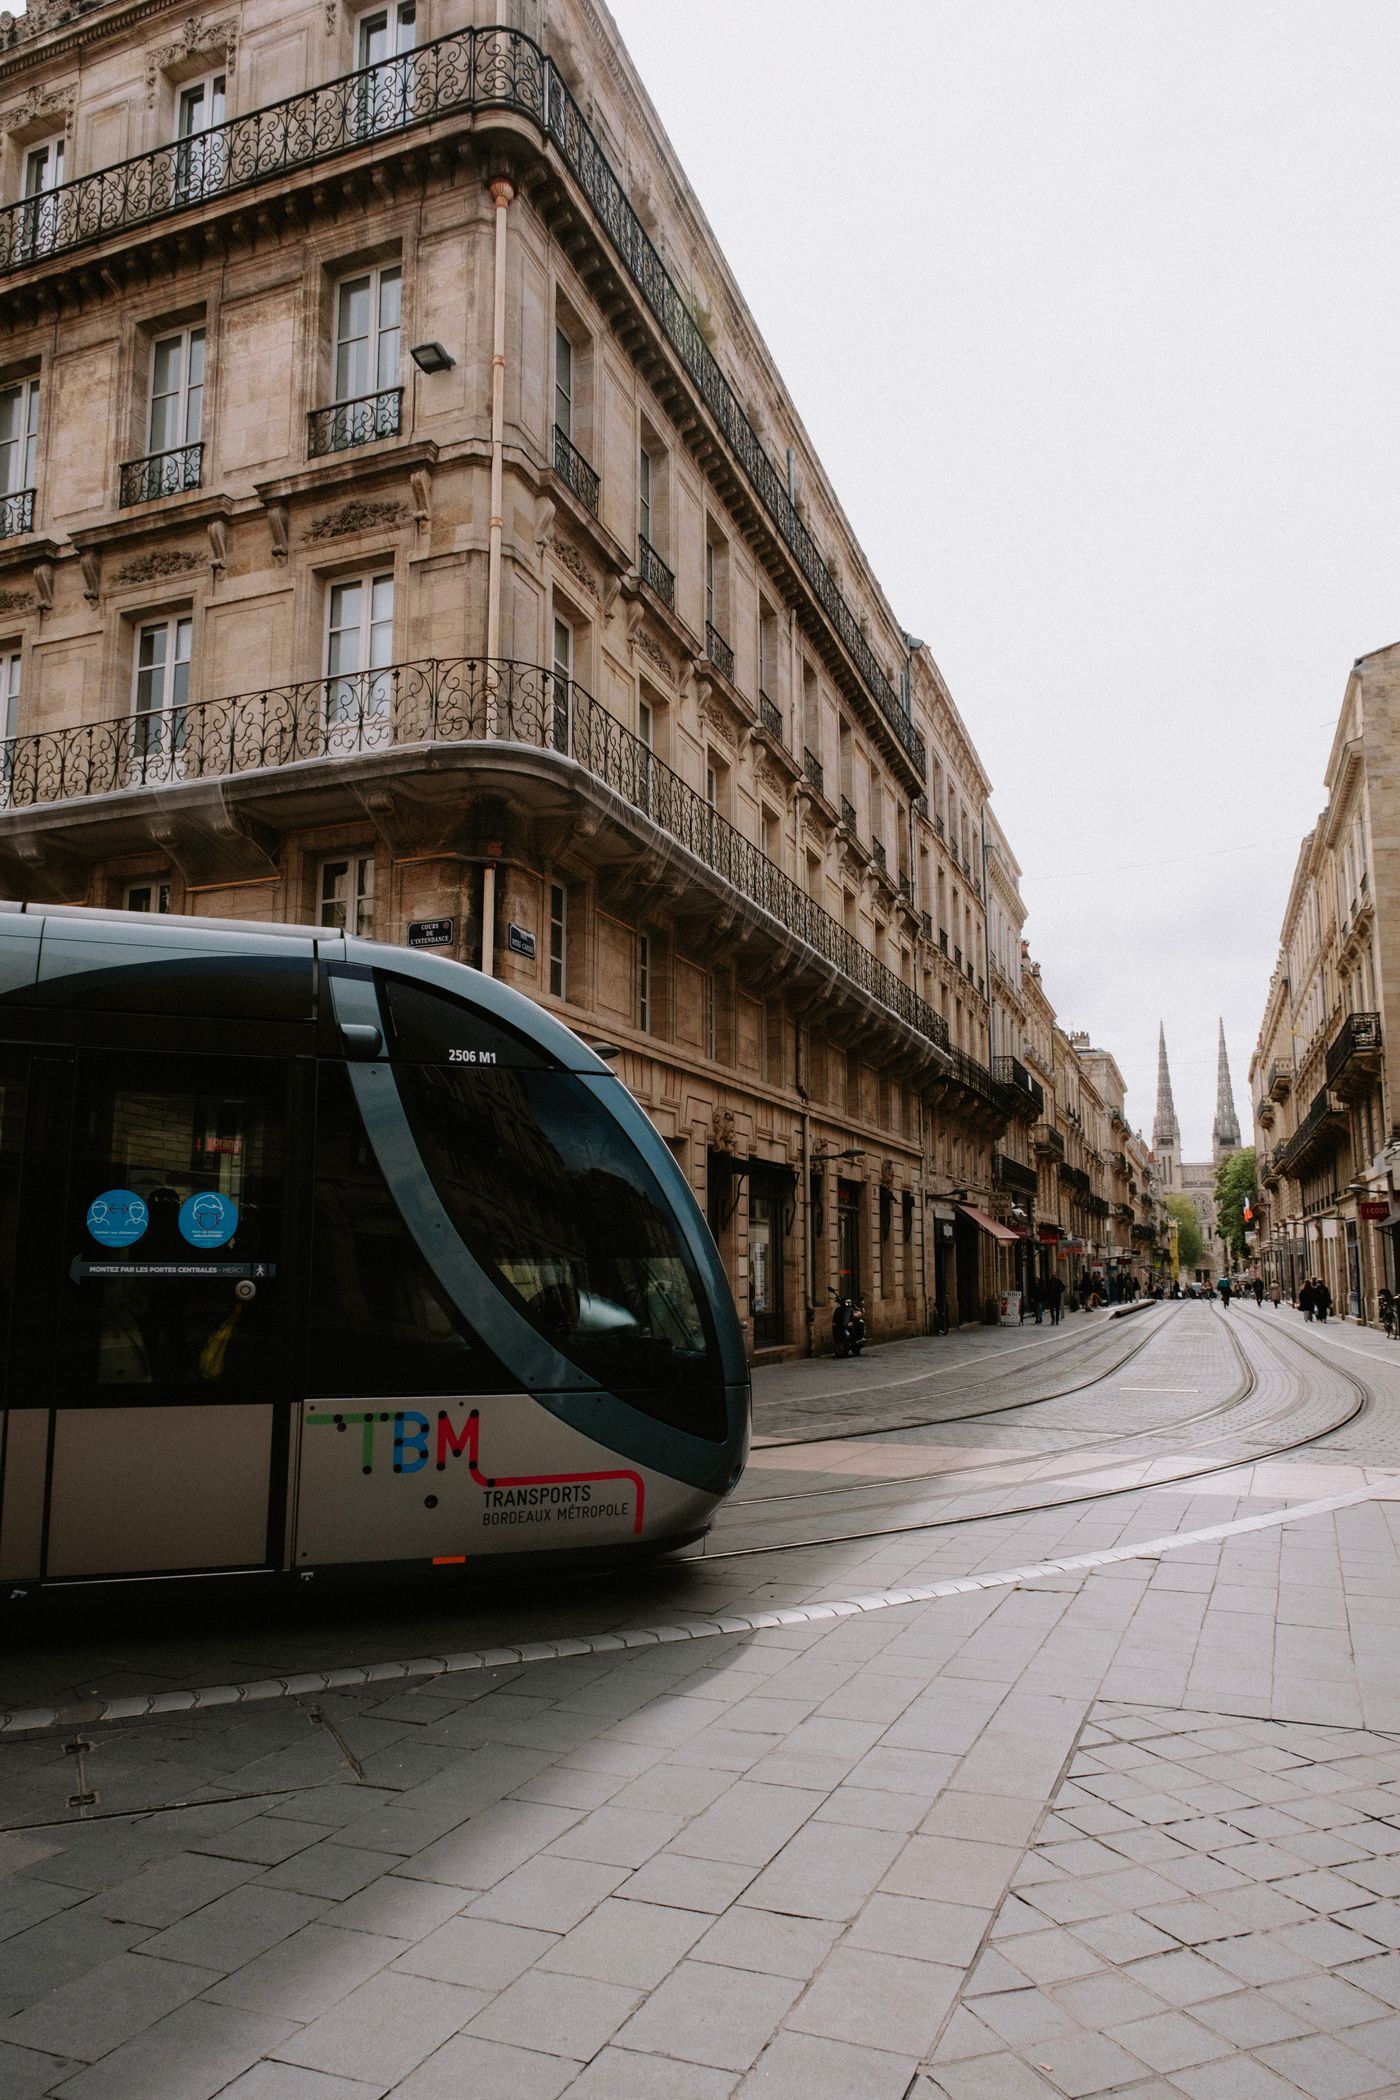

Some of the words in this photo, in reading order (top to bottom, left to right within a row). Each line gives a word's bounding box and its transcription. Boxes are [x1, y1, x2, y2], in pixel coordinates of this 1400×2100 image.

[410, 935, 449, 945] L'INTENDANCE
[448, 1049, 476, 1062] 2506
[479, 1051, 496, 1064] M1
[212, 1138, 241, 1151] orang
[305, 1408, 480, 1474] TBM
[483, 1485, 592, 1508] TRANSPORTS
[482, 1508, 551, 1526] BORDEAUX
[556, 1502, 629, 1521] MÉTROPOLE
